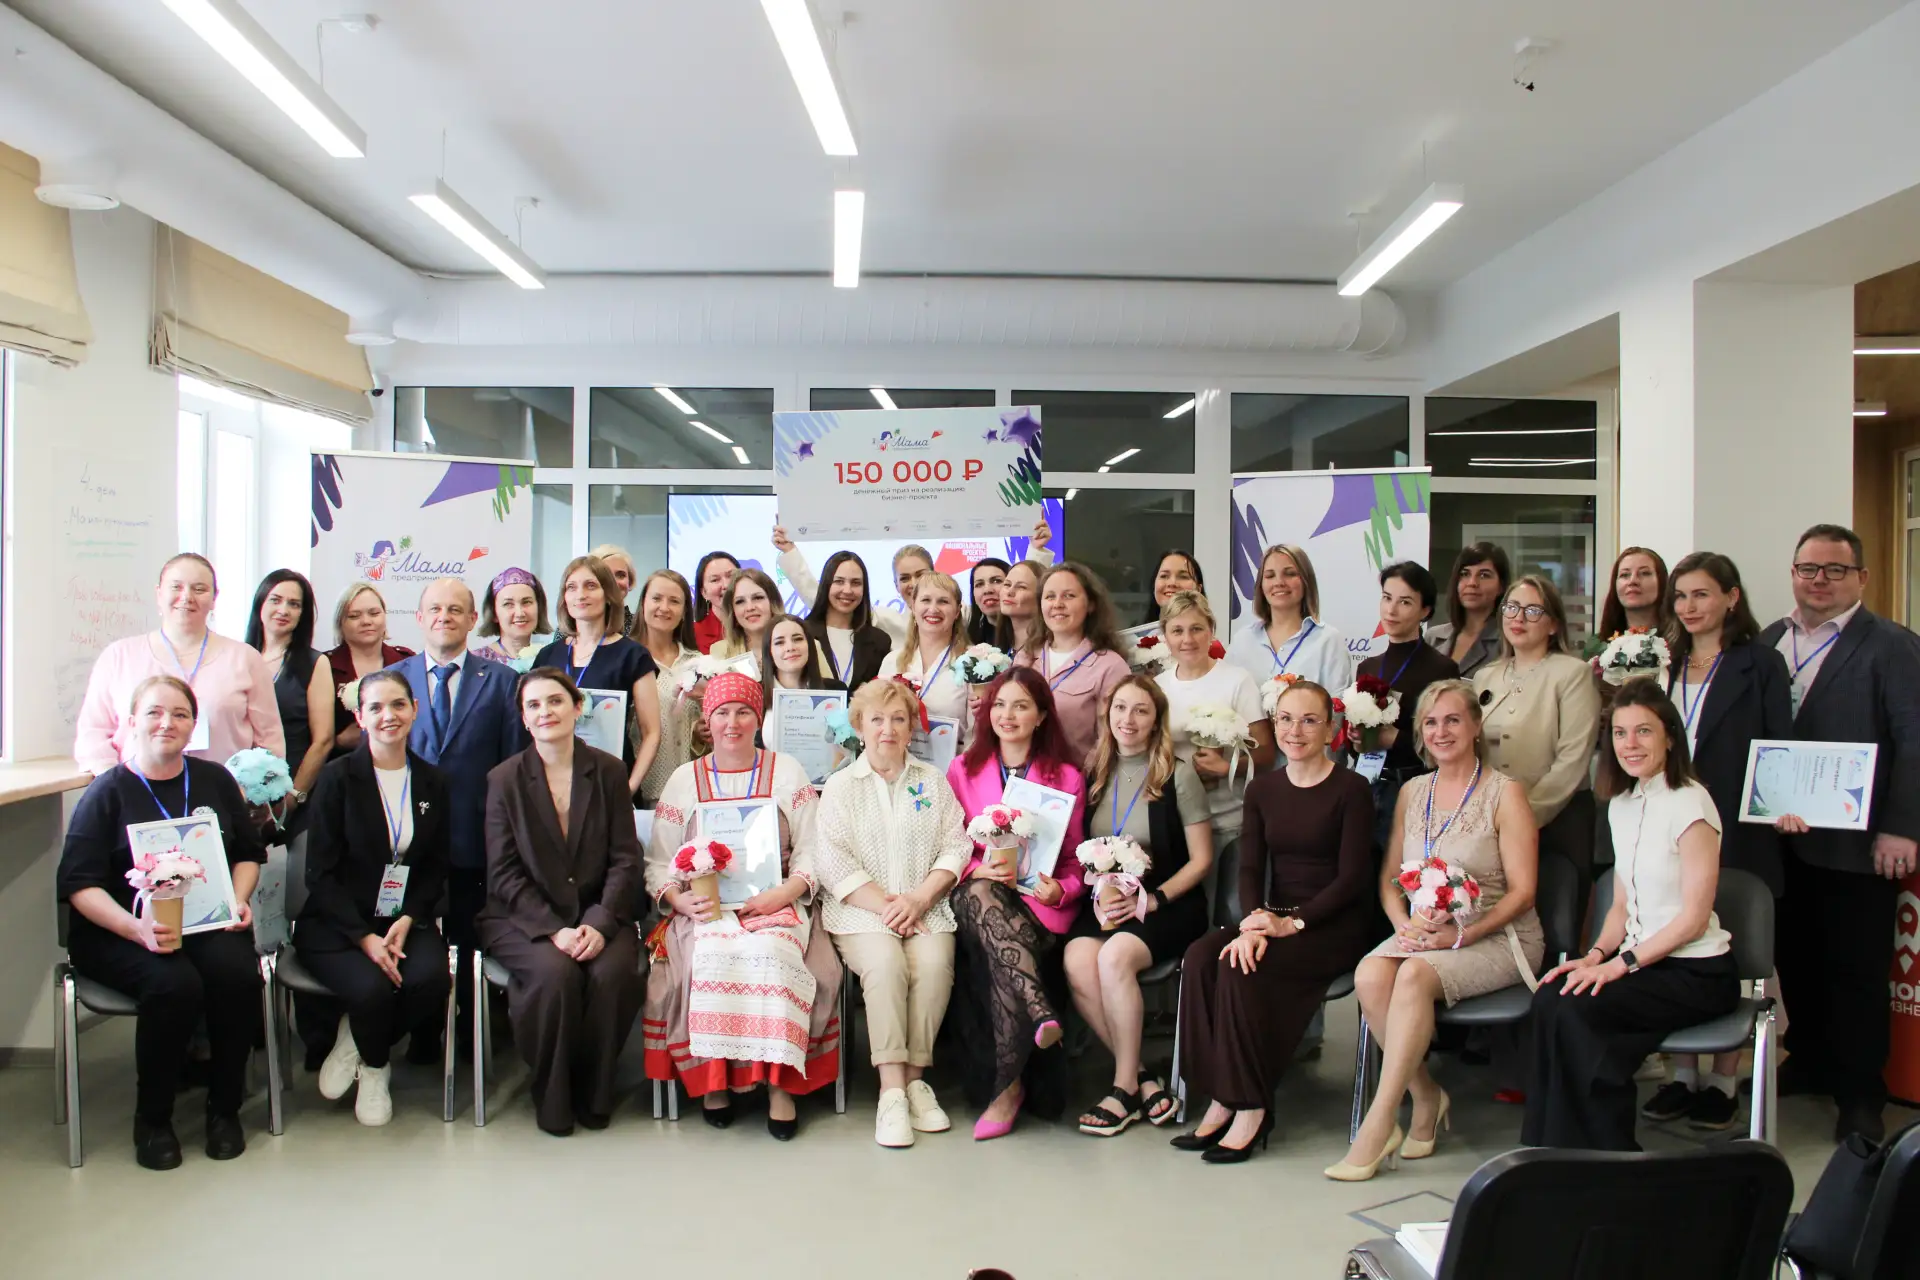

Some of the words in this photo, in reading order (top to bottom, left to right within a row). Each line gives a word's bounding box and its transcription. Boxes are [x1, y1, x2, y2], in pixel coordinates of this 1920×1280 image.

[892, 435, 929, 447] Мама
[834, 461, 883, 484] 150
[893, 459, 952, 482] 000
[962, 459, 984, 480] ₽
[853, 487, 891, 495] денежный
[892, 487, 910, 495] приз
[921, 486, 966, 494] реализацию
[392, 550, 466, 574] Мама
